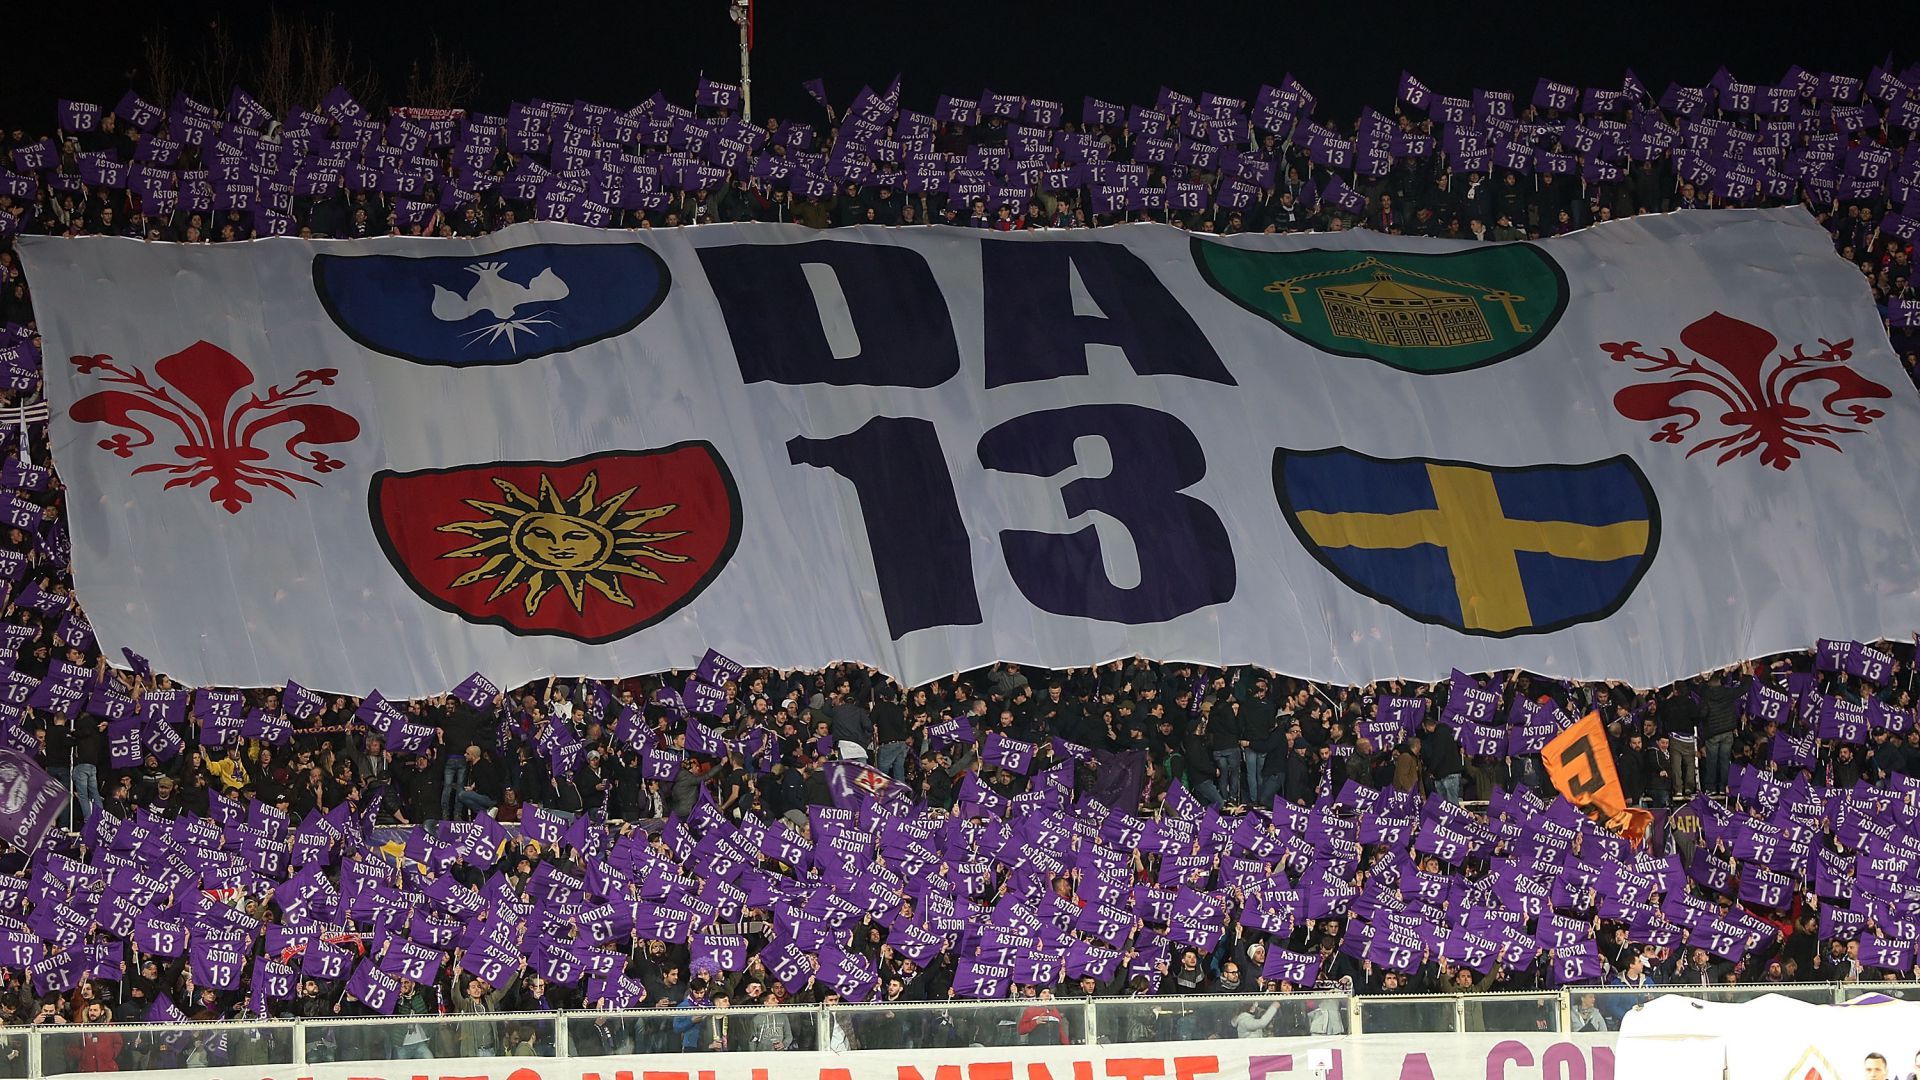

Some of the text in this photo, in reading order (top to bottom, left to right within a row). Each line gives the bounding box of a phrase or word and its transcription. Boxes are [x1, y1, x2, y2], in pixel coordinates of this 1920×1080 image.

[1547, 81, 1574, 94] ASTORI
[1729, 84, 1756, 92] ASTORI
[1768, 88, 1796, 97] ASTORI
[1831, 86, 1849, 99] 13
[184, 97, 211, 114] ASTORI
[712, 92, 730, 105] 13
[1031, 100, 1057, 109] ASTORI
[1443, 97, 1469, 107] ASTORI
[1549, 93, 1566, 108] 13
[1732, 96, 1750, 109] 13
[1772, 100, 1789, 112] 13
[70, 102, 97, 112] ASTORI
[521, 107, 548, 117] ASTORI
[73, 114, 91, 128] 13
[614, 117, 640, 128] ASTORI
[1034, 110, 1051, 123] 13
[1445, 109, 1463, 122] 13
[470, 125, 497, 135] ASTORI
[523, 118, 540, 132] 13
[1768, 122, 1794, 130] ASTORI
[719, 138, 744, 152] ASTORI
[979, 147, 1006, 155] ASTORI
[1323, 138, 1350, 149] ASTORI
[411, 156, 438, 166] ASTORI
[719, 151, 737, 166] 13
[982, 158, 999, 170] 13
[1326, 150, 1344, 163] 13
[141, 168, 169, 179] ASTORI
[697, 167, 724, 177] ASTORI
[1116, 165, 1144, 173] ASTORI
[226, 184, 254, 192] ASTORI
[922, 178, 939, 190] 13
[518, 185, 535, 199] 13
[1180, 193, 1198, 206] 13
[229, 194, 247, 208] 13
[695, 239, 1239, 389] DA
[19, 473, 39, 488] 13
[11, 498, 40, 512] ASTORI
[11, 510, 29, 527] 13
[785, 403, 1237, 641] 13
[5, 625, 35, 635] ASTORI
[1860, 647, 1891, 664] ASTORI
[61, 664, 92, 677] ASTORI
[713, 655, 741, 673] ASTORI
[1862, 660, 1882, 679] 13
[9, 685, 28, 703] 13
[50, 683, 82, 700] ASTORI
[296, 687, 324, 705] ASTORI
[468, 688, 488, 707] 13
[695, 684, 725, 700] ASTORI
[1464, 687, 1495, 702] ASTORI
[104, 700, 124, 718] 13
[696, 698, 715, 712] 13
[1464, 702, 1486, 717] 13
[1760, 701, 1780, 718] 13
[1834, 713, 1863, 723] ASTORI
[1882, 714, 1904, 730] 13
[158, 719, 181, 745] ASTORI
[400, 724, 433, 736] ASTORI
[1369, 722, 1399, 732] ASTORI
[1474, 726, 1504, 738] ASTORI
[1523, 726, 1553, 736] ASTORI
[1837, 724, 1857, 740] 13
[112, 739, 128, 756] 13
[131, 729, 141, 760] ASTORI
[401, 738, 422, 751] 13
[998, 738, 1031, 753] ASTORI
[1477, 739, 1497, 754] 13
[1000, 751, 1020, 768] 13
[652, 763, 672, 777] 13
[820, 809, 852, 819] ASTORI
[538, 822, 557, 842] 13
[255, 838, 286, 853] ASTORI
[299, 834, 327, 846] ASTORI
[830, 837, 864, 852] ASTORI
[197, 848, 227, 861] ASTORI
[259, 852, 278, 871] 13
[780, 844, 802, 864] 13
[1175, 855, 1209, 866] ASTORI
[354, 864, 384, 878] ASTORI
[1233, 860, 1263, 873] ASTORI
[548, 869, 584, 889] ASTORI
[963, 877, 985, 894] 13
[1615, 868, 1650, 889] ASTORI
[1755, 870, 1789, 886] ASTORI
[717, 880, 749, 902] ASTORI
[869, 882, 901, 906] ASTORI
[1616, 882, 1638, 902] 13
[1760, 886, 1780, 904] 13
[679, 894, 713, 915] ASTORI
[826, 894, 862, 915] ASTORI
[1053, 897, 1082, 917] ASTORI
[54, 904, 89, 928] ASTORI
[653, 908, 687, 920] ASTORI
[824, 906, 847, 927] 13
[1097, 905, 1131, 924] ASTORI
[1388, 915, 1422, 926] ASTORI
[1484, 910, 1520, 922] ASTORI
[1831, 911, 1864, 923] ASTORI
[655, 921, 676, 939] 13
[1097, 920, 1119, 939] 13
[1551, 915, 1585, 931] ASTORI
[1711, 919, 1747, 938] ASTORI
[1739, 915, 1774, 936] ASTORI
[8, 932, 39, 944] ASTORI
[152, 934, 173, 953] 13
[704, 936, 739, 946] ASTORI
[996, 934, 1033, 948] ASTORI
[1387, 932, 1422, 950] ASTORI
[1464, 932, 1497, 951] ASTORI
[1502, 926, 1535, 949] ASTORI
[1711, 934, 1733, 954] 13
[13, 946, 33, 965] 13
[207, 950, 238, 964] ASTORI
[401, 943, 438, 960] ASTORI
[484, 946, 517, 967] ASTORI
[784, 943, 810, 974] ASTORI
[1281, 951, 1316, 962] ASTORI
[1388, 947, 1411, 968] 13
[1464, 946, 1486, 966] 13
[1878, 950, 1899, 965] 13
[710, 950, 732, 969] 13
[210, 966, 231, 986] 13
[401, 959, 424, 979] 13
[479, 959, 502, 980] 13
[547, 959, 571, 981] 13
[775, 956, 799, 982] 13
[838, 958, 873, 983] ASTORI
[971, 964, 1008, 977] ASTORI
[1030, 964, 1052, 982] 13
[1283, 964, 1305, 980] 13
[269, 977, 288, 996] 13
[368, 967, 398, 991] ASTORI
[835, 975, 859, 995] 13
[974, 979, 997, 996] 13
[364, 987, 386, 1009] 13
